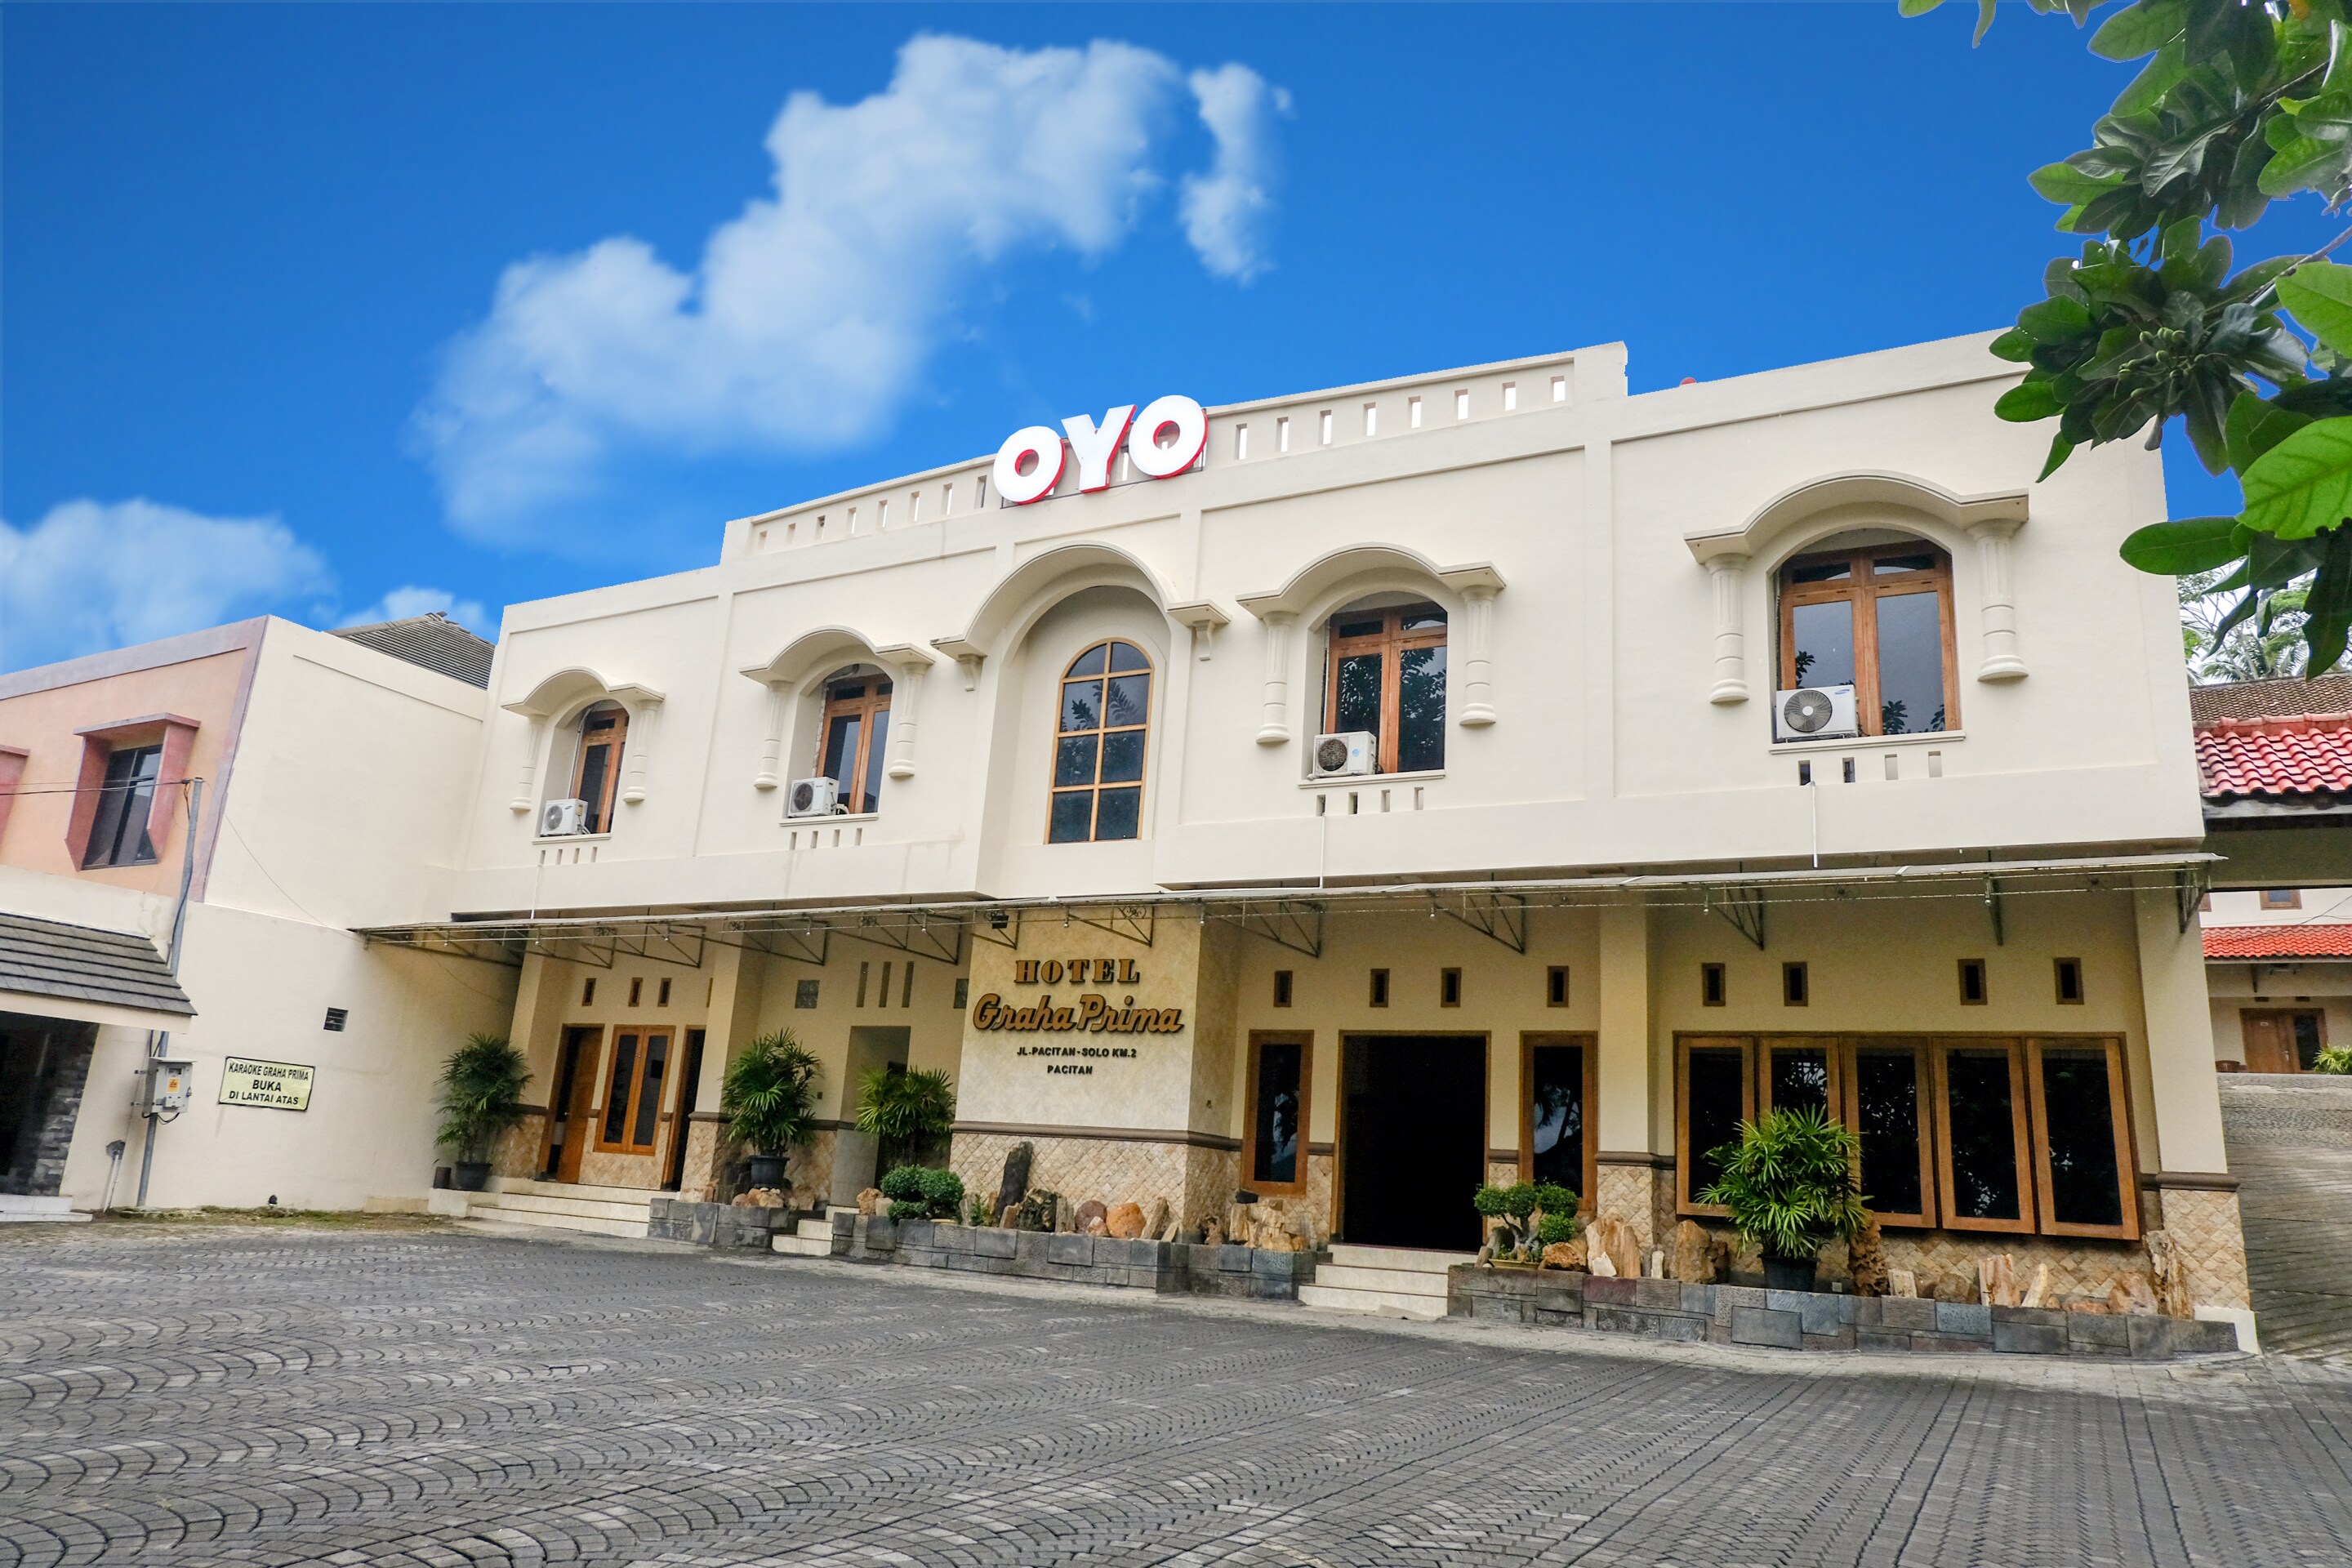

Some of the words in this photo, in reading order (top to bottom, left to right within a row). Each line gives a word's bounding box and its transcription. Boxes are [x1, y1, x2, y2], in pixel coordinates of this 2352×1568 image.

[993, 394, 1209, 505] OYO
[1014, 959, 1140, 984] HOTEL
[973, 993, 1077, 1031] Graha
[1076, 994, 1184, 1033] Prima
[229, 1062, 262, 1076] KARAOKE
[263, 1067, 286, 1078] GRAHA
[287, 1069, 309, 1080] PRIMA
[1047, 1065, 1093, 1075] PACITAN
[252, 1080, 282, 1092] BUKA
[229, 1091, 239, 1099] DI
[242, 1092, 274, 1102] LANTAI
[276, 1096, 299, 1105] ATAS
